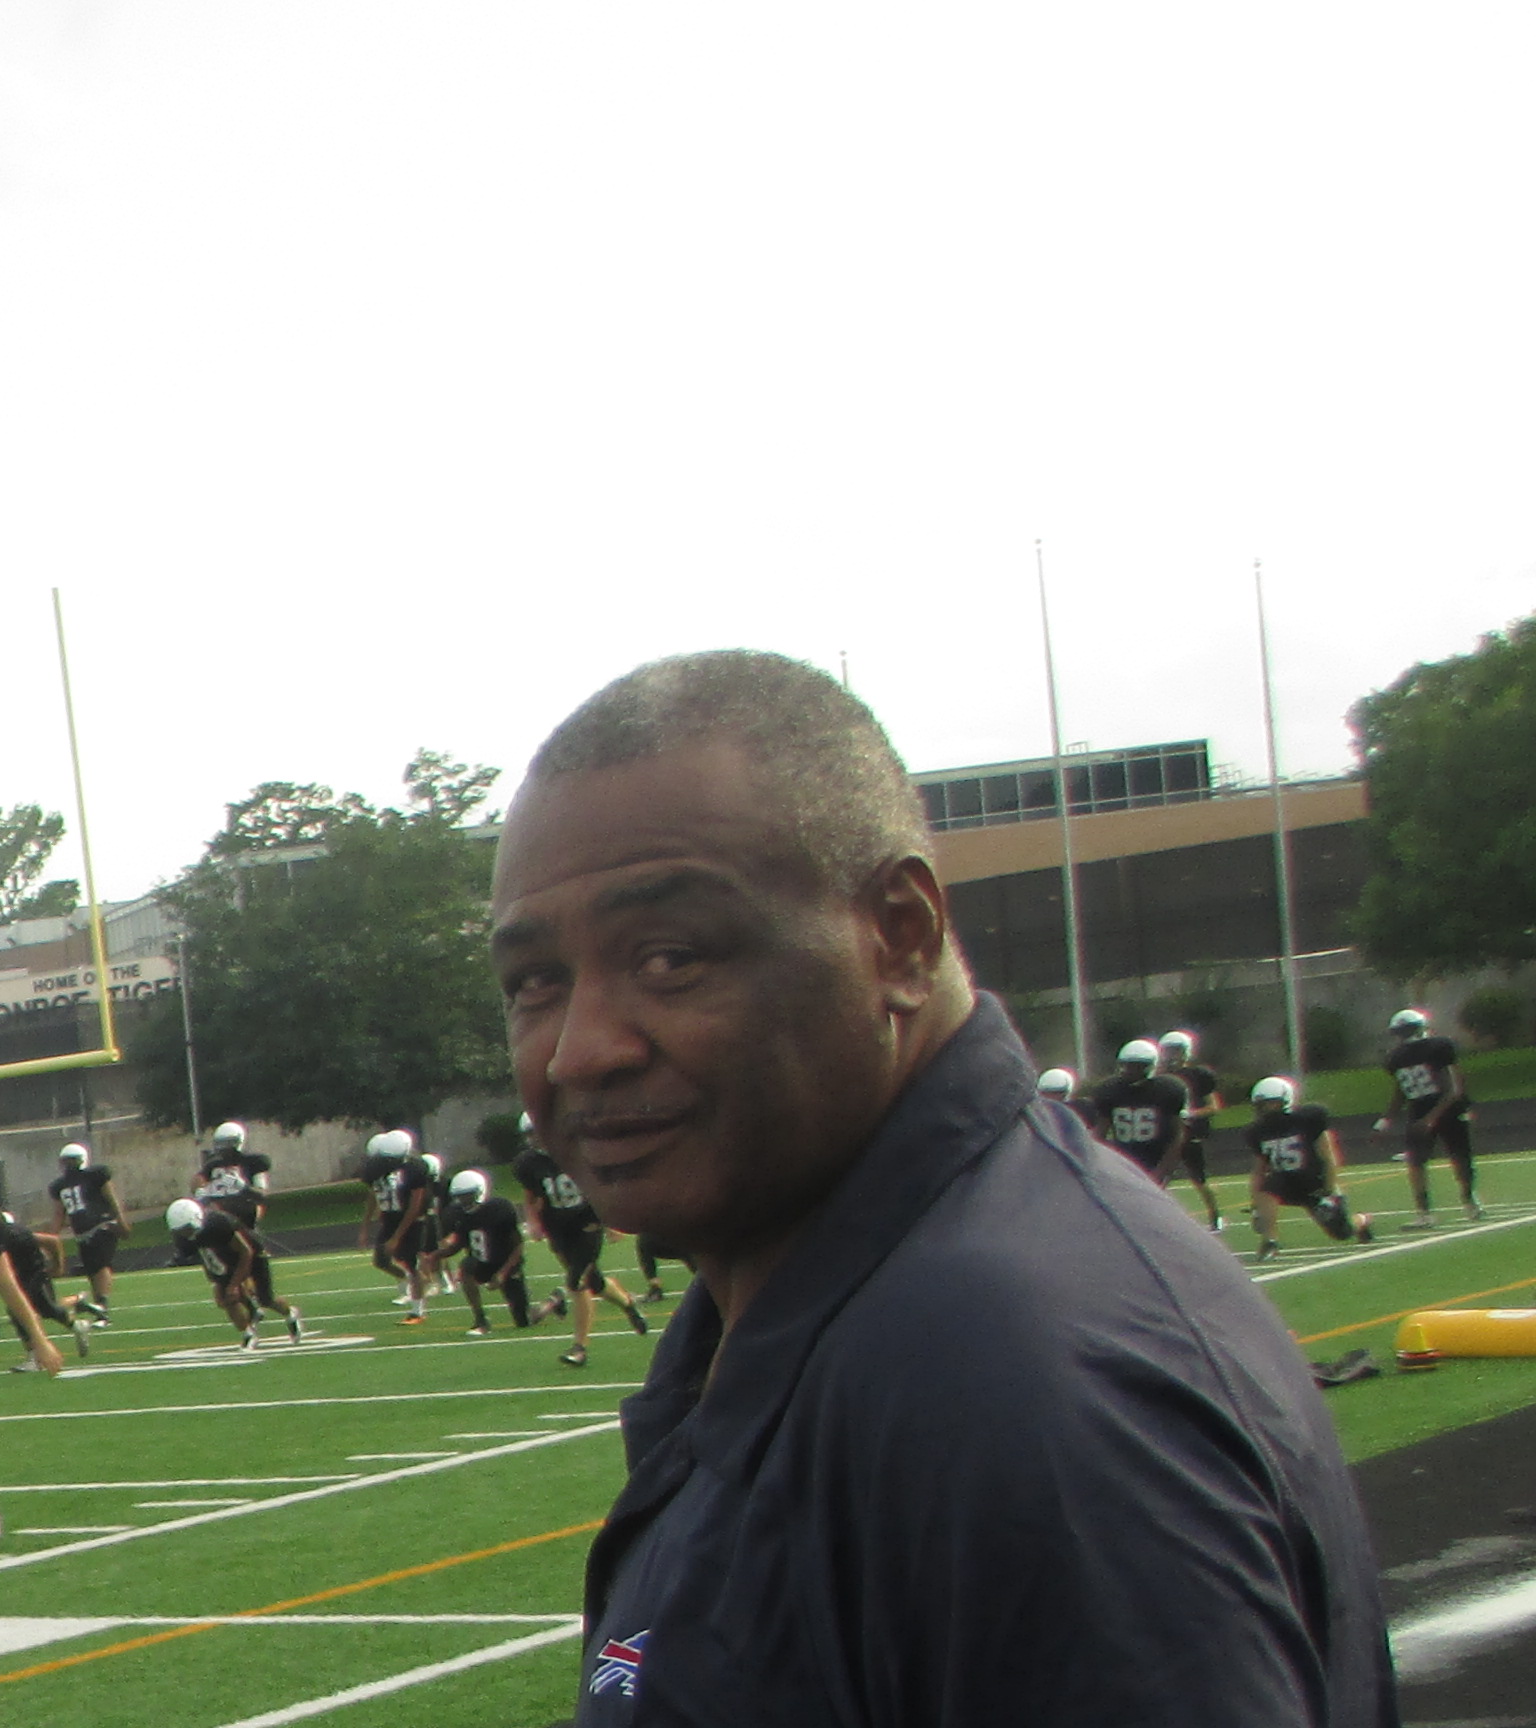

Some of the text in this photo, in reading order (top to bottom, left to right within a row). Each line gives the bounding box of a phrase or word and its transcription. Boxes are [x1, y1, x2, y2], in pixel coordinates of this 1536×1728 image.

[32, 963, 141, 993] HOME O THE
[1261, 1134, 1306, 1172] 75
